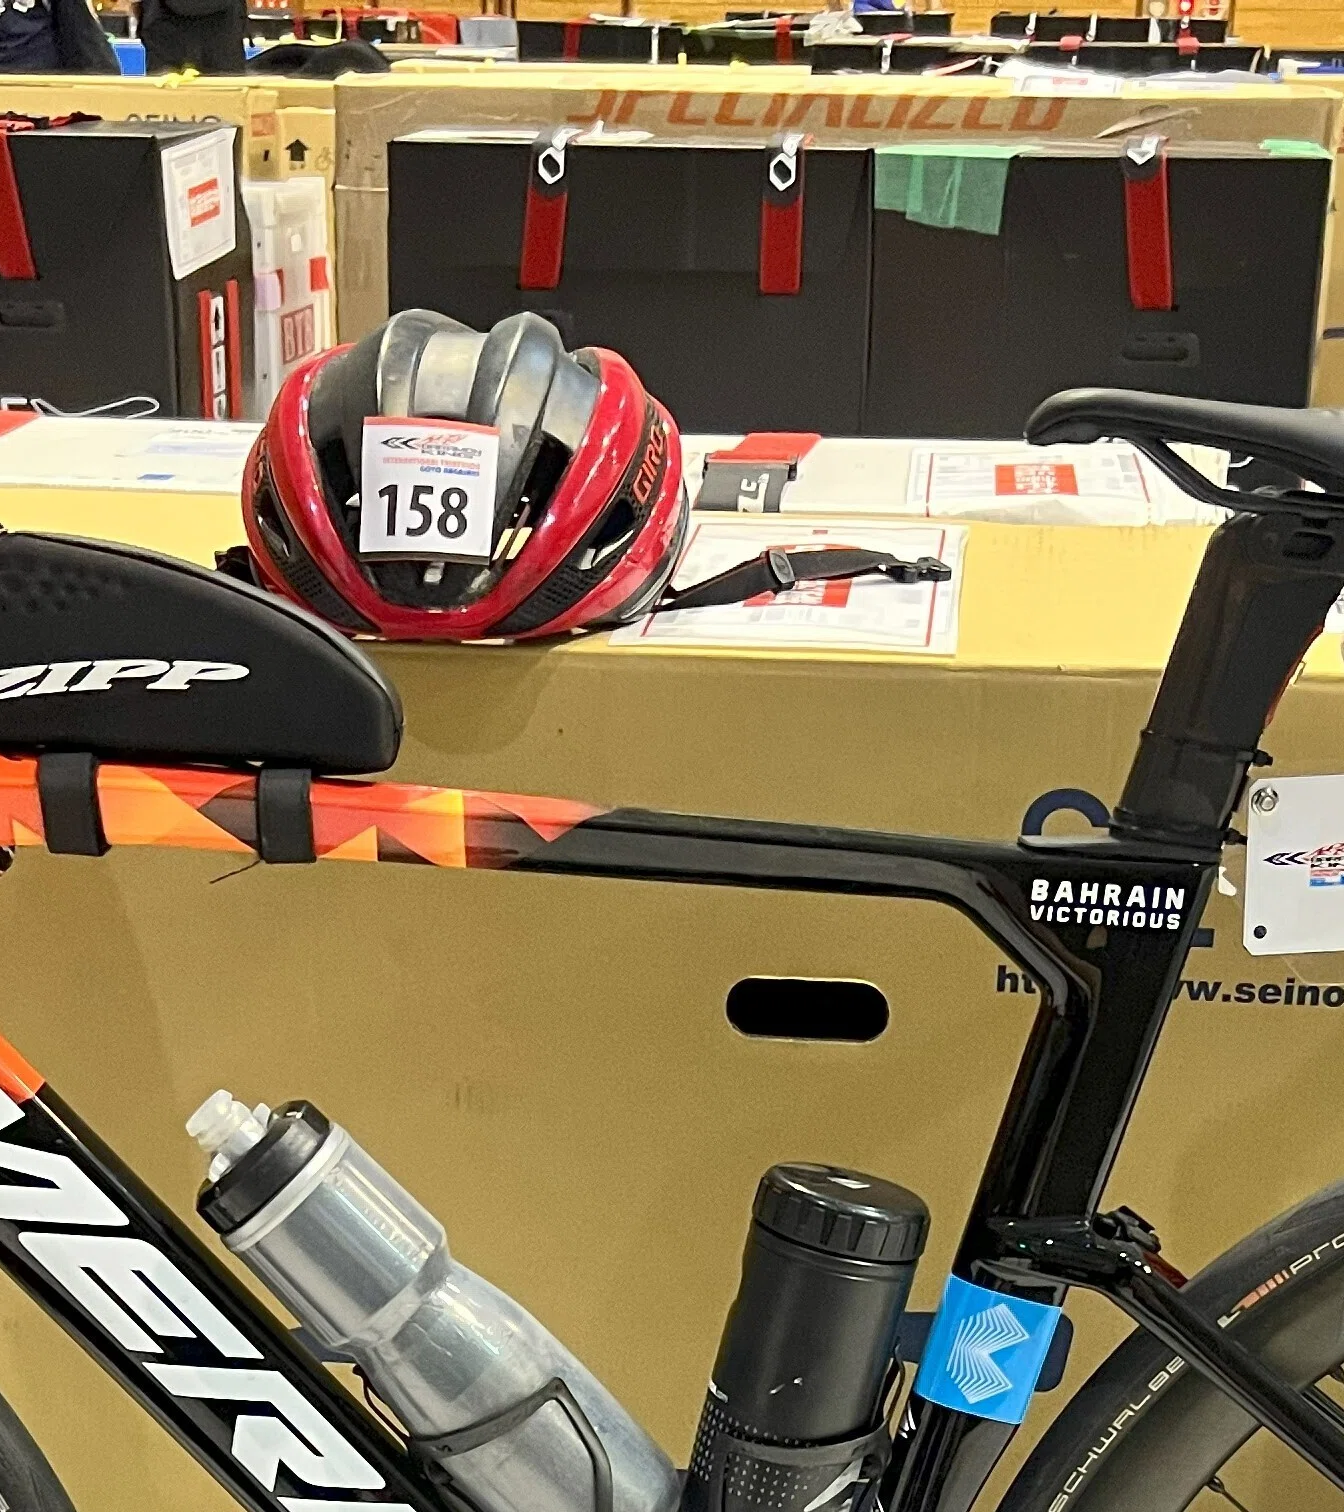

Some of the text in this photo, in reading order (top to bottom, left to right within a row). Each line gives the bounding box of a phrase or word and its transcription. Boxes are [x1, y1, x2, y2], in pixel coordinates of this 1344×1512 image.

[631, 421, 666, 504] GIRO
[377, 484, 468, 539] 158
[1030, 878, 1186, 911] BAHRAIN
[1029, 904, 1182, 931] VICTORIOUS
